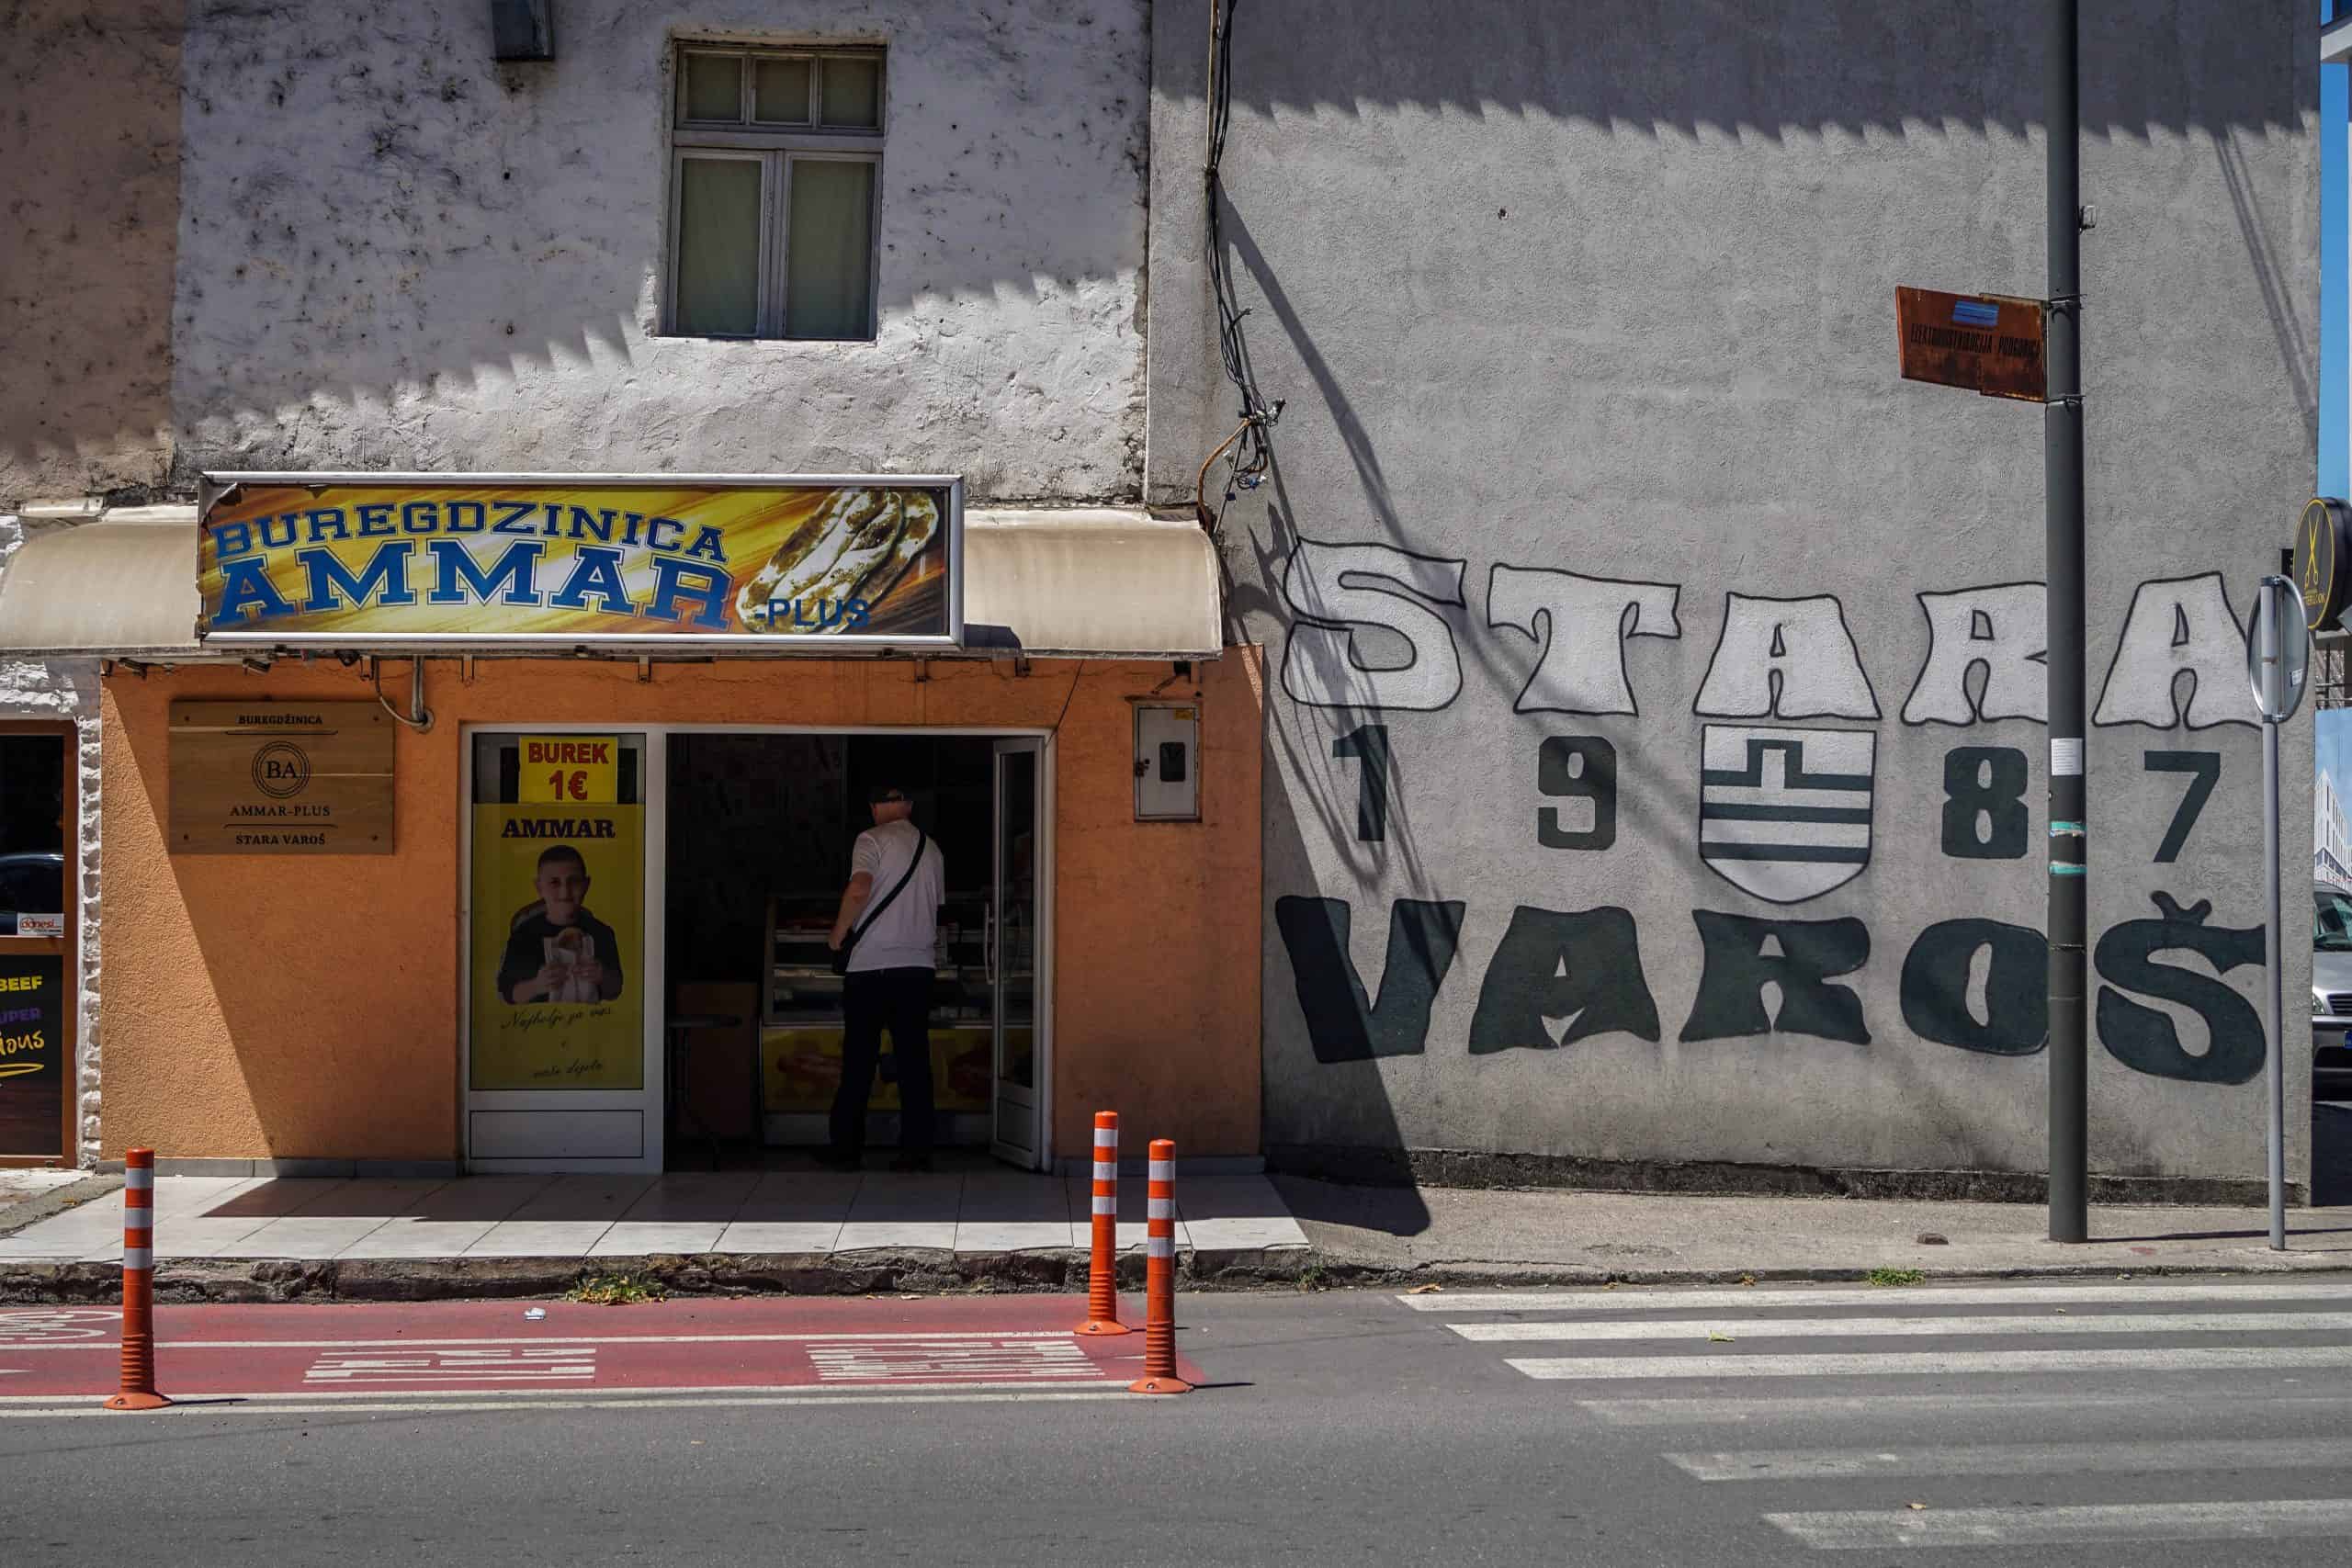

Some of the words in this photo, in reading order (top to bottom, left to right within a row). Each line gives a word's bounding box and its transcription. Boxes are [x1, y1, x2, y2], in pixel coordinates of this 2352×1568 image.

[210, 501, 729, 562] BUREGDZINICA
[209, 538, 736, 633] AMMAR
[1281, 536, 2264, 731] STARA
[527, 741, 609, 765] BUREK
[264, 760, 300, 780] BA
[548, 769, 588, 801] 1€
[235, 834, 279, 845] STARA
[283, 832, 326, 846] VAROŠ
[500, 818, 616, 839] AMMAR
[1275, 890, 2269, 1085] VAROŠ
